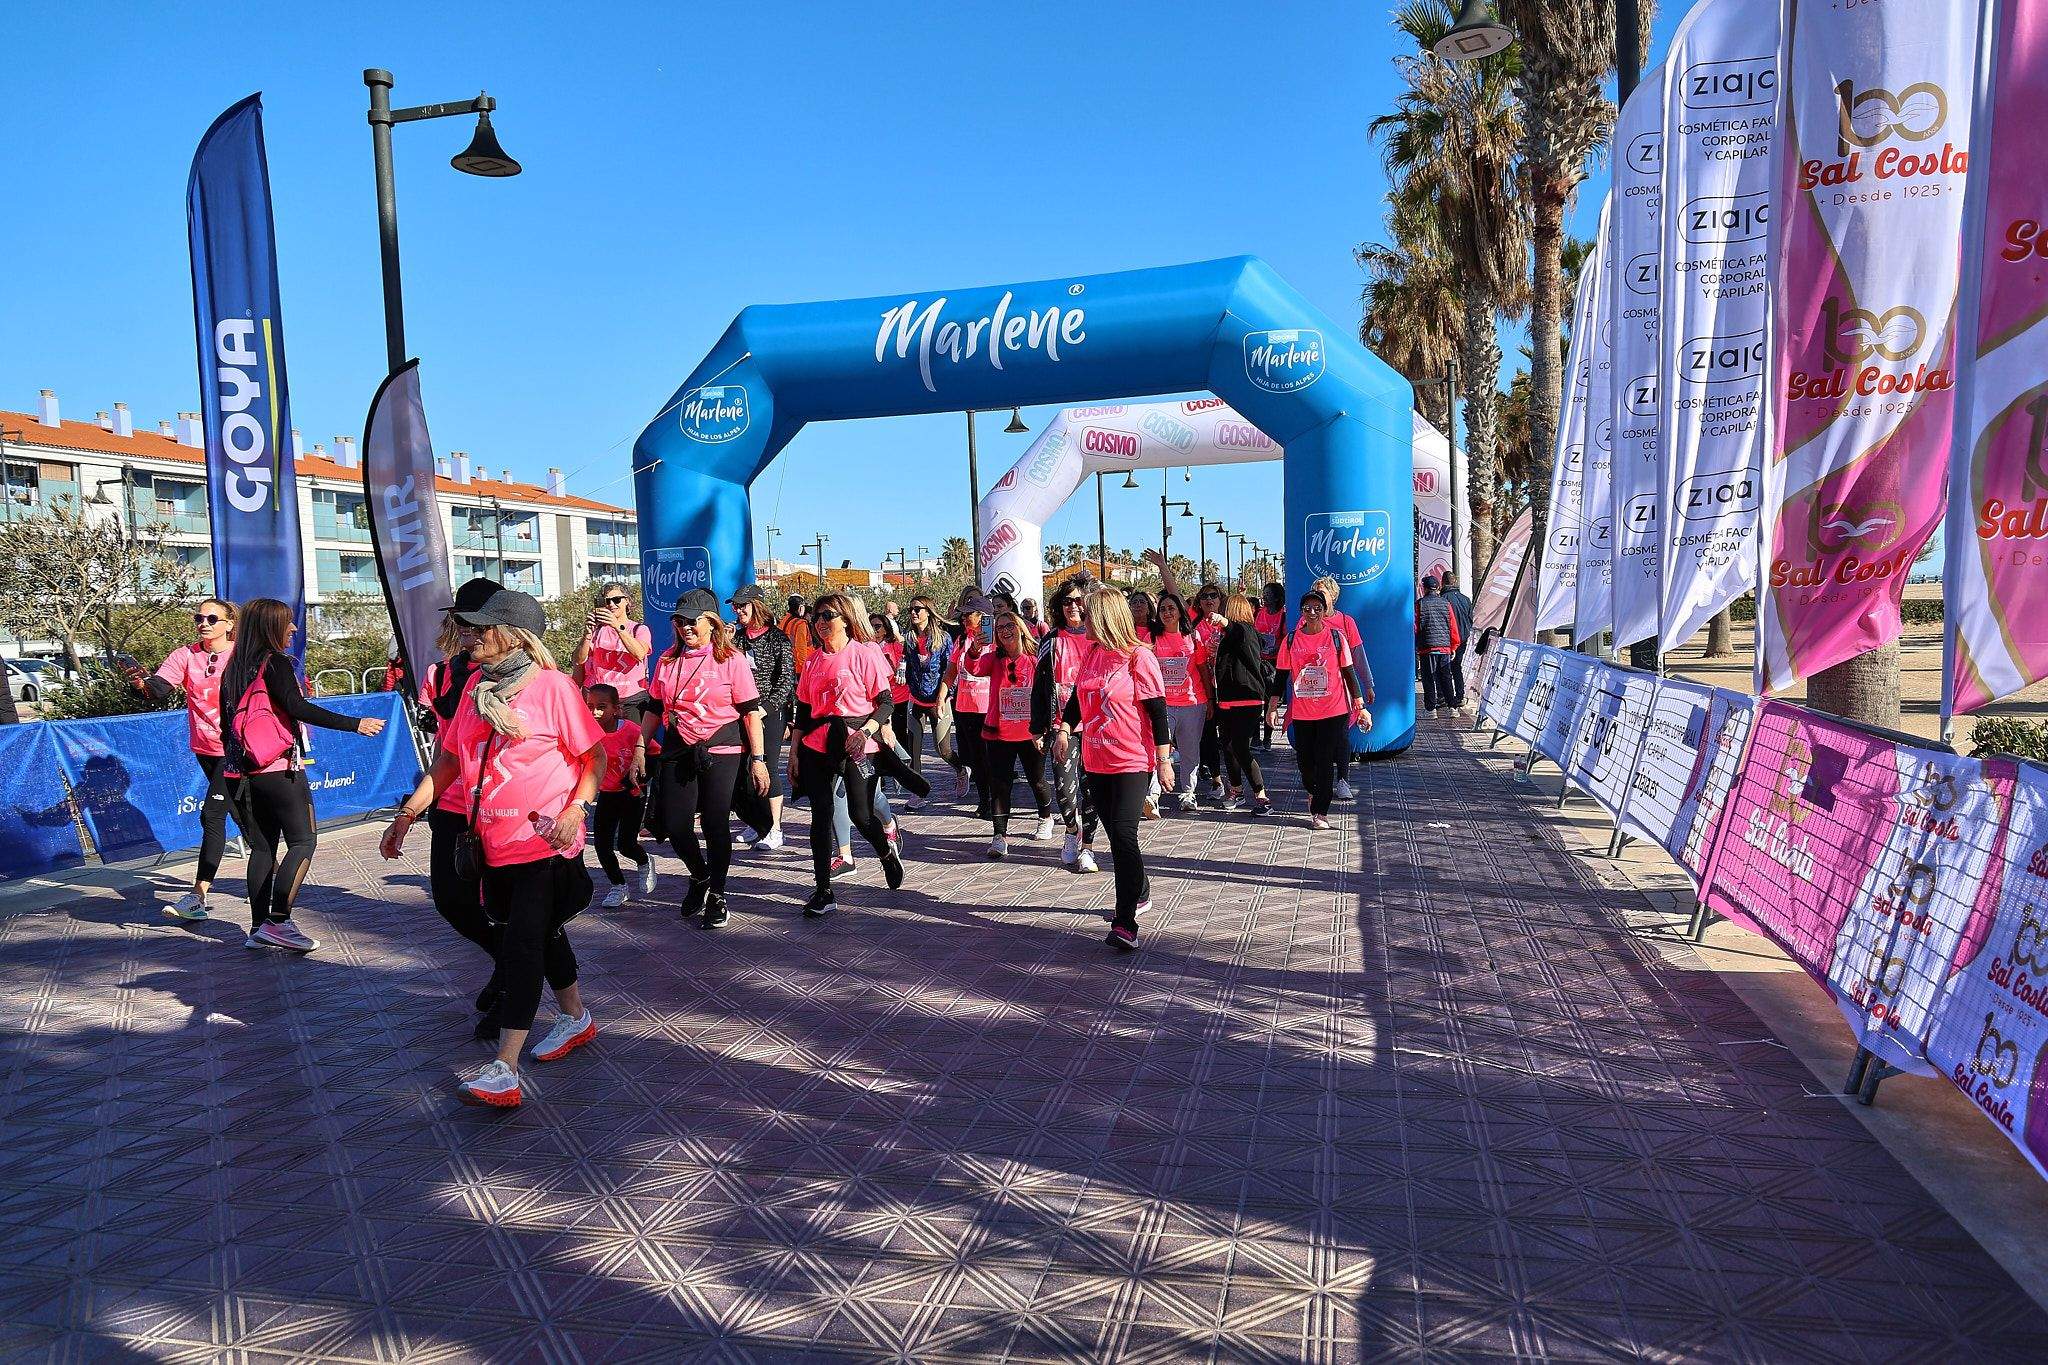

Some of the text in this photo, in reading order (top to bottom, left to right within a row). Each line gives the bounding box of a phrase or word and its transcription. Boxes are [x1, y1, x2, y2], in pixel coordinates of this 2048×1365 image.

[1678, 119, 1749, 135] COSMÉTICA
[1702, 131, 1771, 147] CORPORAL
[1705, 146, 1769, 161] Y CAPILAR
[1800, 143, 1969, 190] Sal Costa
[1834, 184, 1941, 206] Desde 1925
[1675, 257, 1746, 272] COSMÉTICA
[1700, 268, 1766, 284] CORPORAL
[1703, 283, 1764, 298] Y CAPILAR
[875, 291, 1086, 392] Marlene
[1251, 342, 1319, 377] Marlene
[1281, 381, 1294, 389] LOS
[1295, 371, 1315, 386] ALPES
[1787, 363, 1955, 401] Sal Costa
[215, 319, 272, 513] GOYA
[684, 399, 744, 428] Marlene
[1674, 395, 1743, 410] COSMÉTICA
[1699, 406, 1757, 422] CORPORA
[1817, 402, 1914, 419] Desde 1925
[710, 432, 723, 440] LOS
[723, 426, 741, 439] ALPES
[1085, 429, 1137, 456] COSMO
[1143, 411, 1194, 450] COSMO
[1219, 423, 1271, 449] COSMO
[1701, 427, 1708, 437] Y
[384, 474, 434, 591] IMR
[980, 523, 1016, 568] COSMO
[1310, 527, 1385, 566] Marlene
[647, 561, 706, 596] Marlene
[1330, 571, 1340, 580] DE
[1342, 572, 1357, 580] LOS
[1358, 563, 1380, 578] ALPES
[1769, 549, 1909, 588] Sal Cost
[324, 771, 355, 789] bueno!
[1920, 812, 1959, 842] Costa
[1745, 808, 1774, 850] Sal
[1771, 821, 1814, 882] Costa
[1987, 957, 2015, 990] Sal
[1952, 1062, 2014, 1133] Sal Costa
